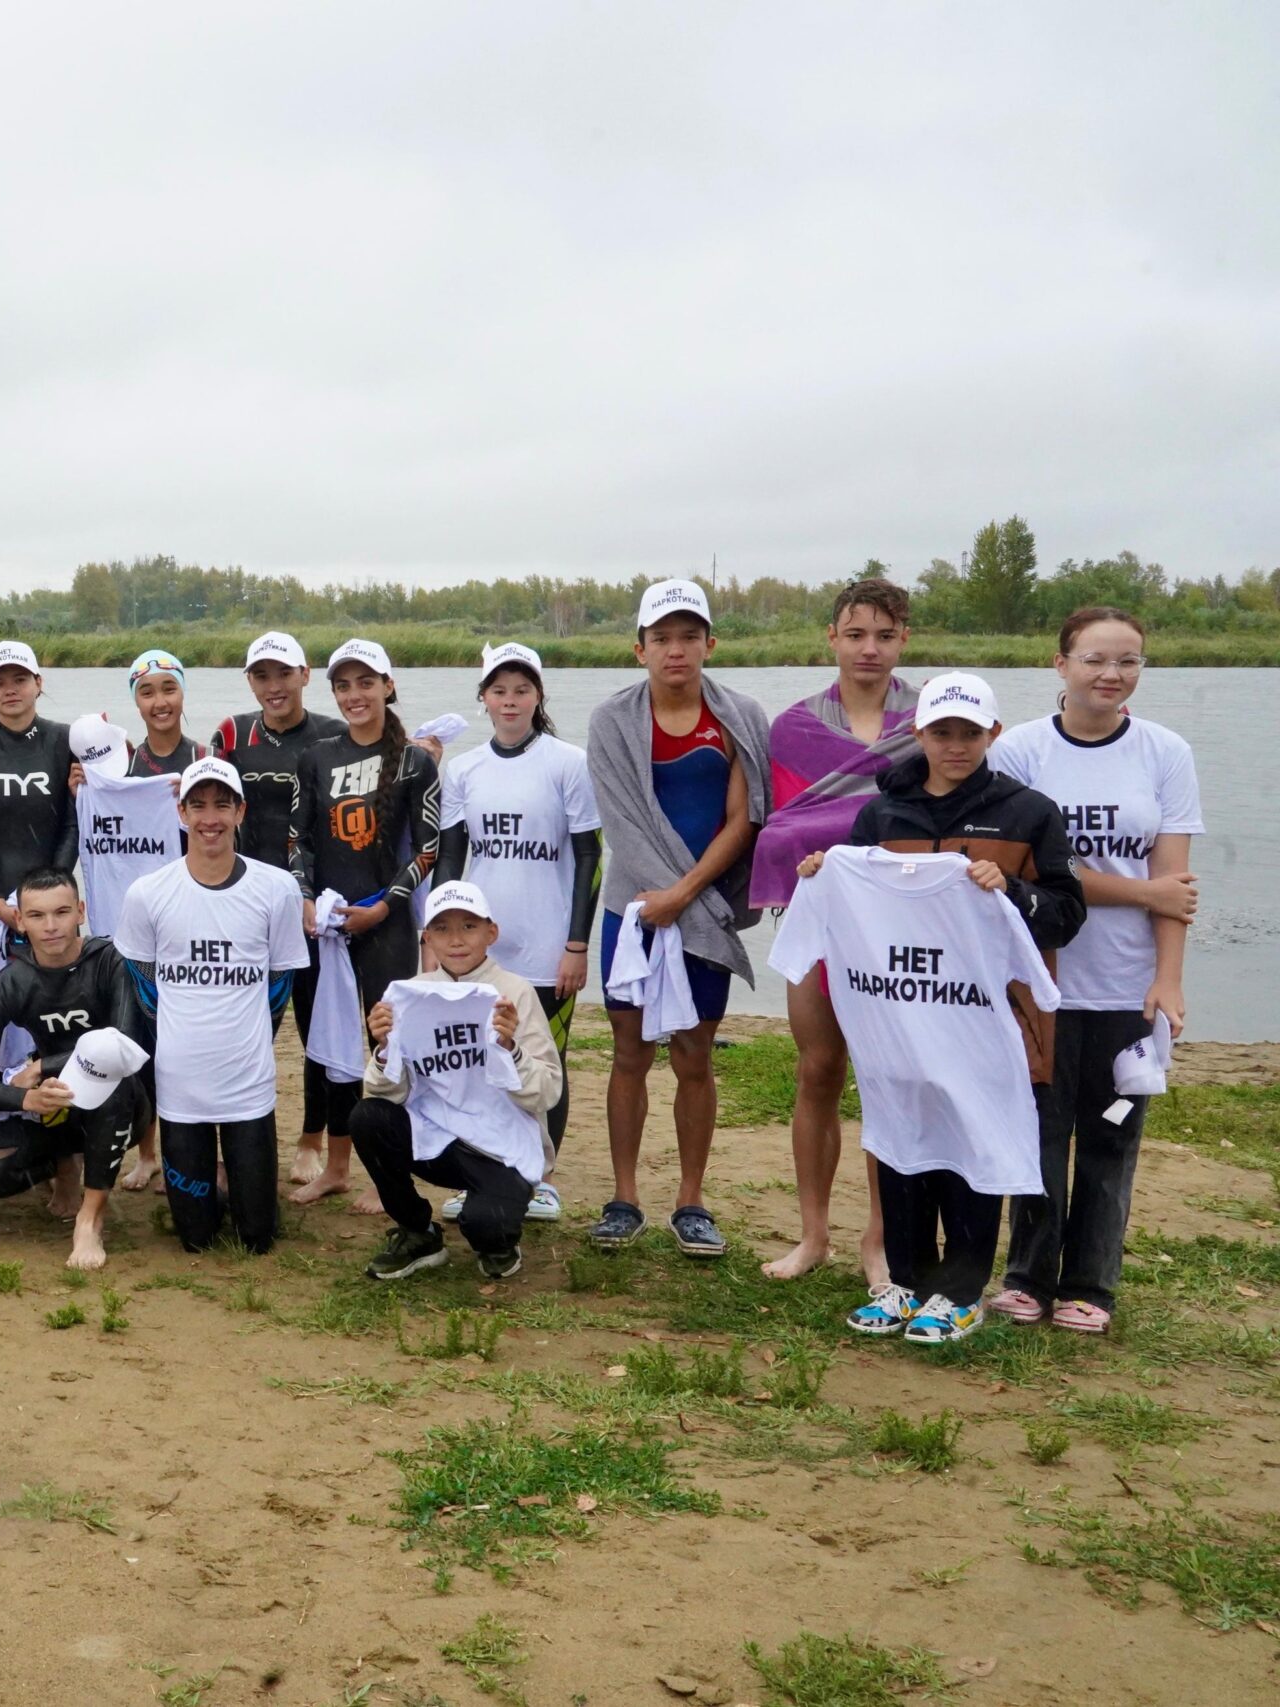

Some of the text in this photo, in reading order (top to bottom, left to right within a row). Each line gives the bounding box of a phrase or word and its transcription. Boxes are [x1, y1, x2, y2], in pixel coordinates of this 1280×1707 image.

[651, 594, 701, 610] НАРКОТИКАМ
[666, 588, 683, 597] НЕТ
[346, 643, 360, 651] НЕТ
[930, 692, 981, 707] НАРКОТИКАМ
[945, 686, 962, 694] НЕТ
[26, 726, 39, 740] TYR
[93, 814, 124, 836] НЕТ
[482, 813, 524, 836] НЕТ
[1062, 805, 1119, 830] НЕТ
[444, 889, 458, 897] НЕТ
[190, 940, 233, 963] НЕТ
[889, 945, 944, 975] НЕТ
[847, 967, 995, 1013] НАРКОТИКАМ
[39, 1009, 93, 1033] TYR
[433, 1023, 480, 1050] НЕТ
